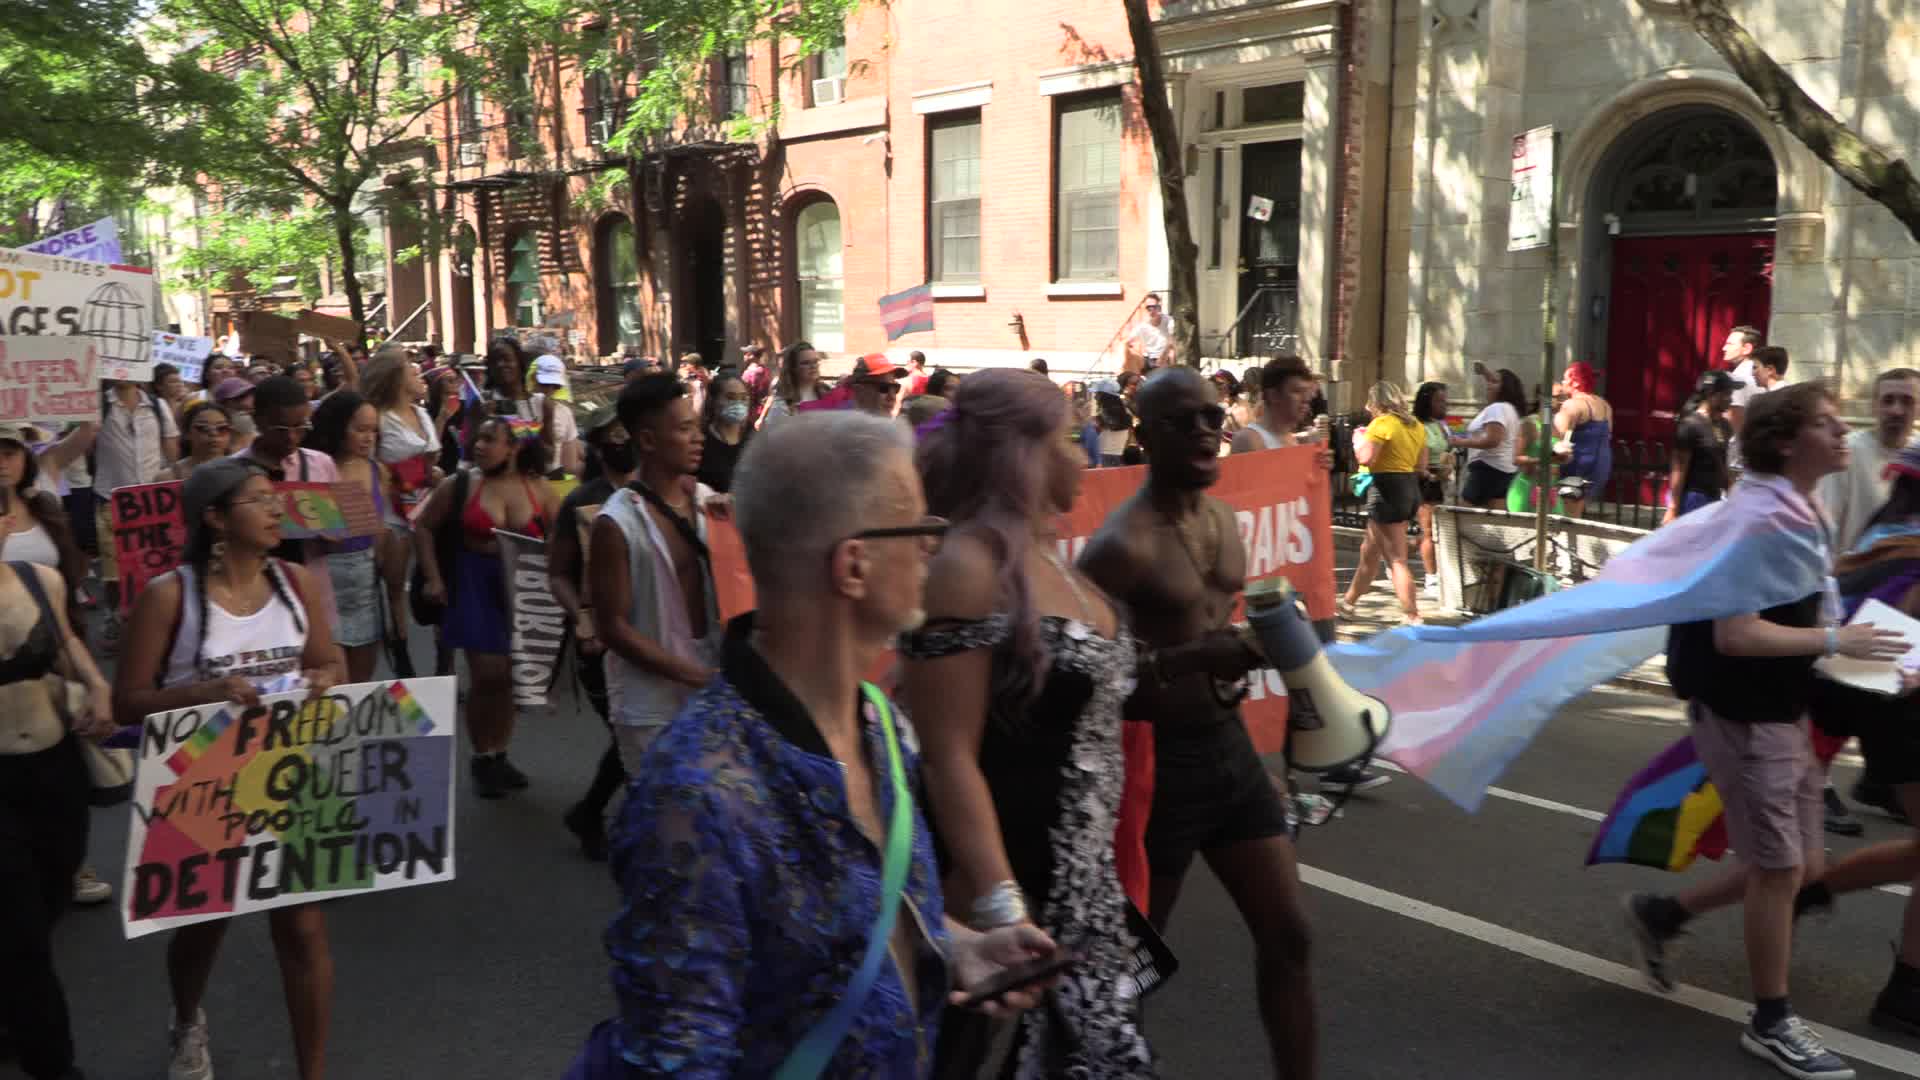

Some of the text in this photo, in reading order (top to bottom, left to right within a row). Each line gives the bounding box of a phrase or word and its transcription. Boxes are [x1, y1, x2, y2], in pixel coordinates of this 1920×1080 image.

[0, 305, 80, 336] GES
[113, 522, 173, 552] THE
[1232, 495, 1312, 576] RANS
[143, 689, 403, 760] NO FREEDOM
[130, 740, 413, 827] WITH QUEER
[394, 797, 421, 824] IN
[130, 826, 448, 921] DETENTION
